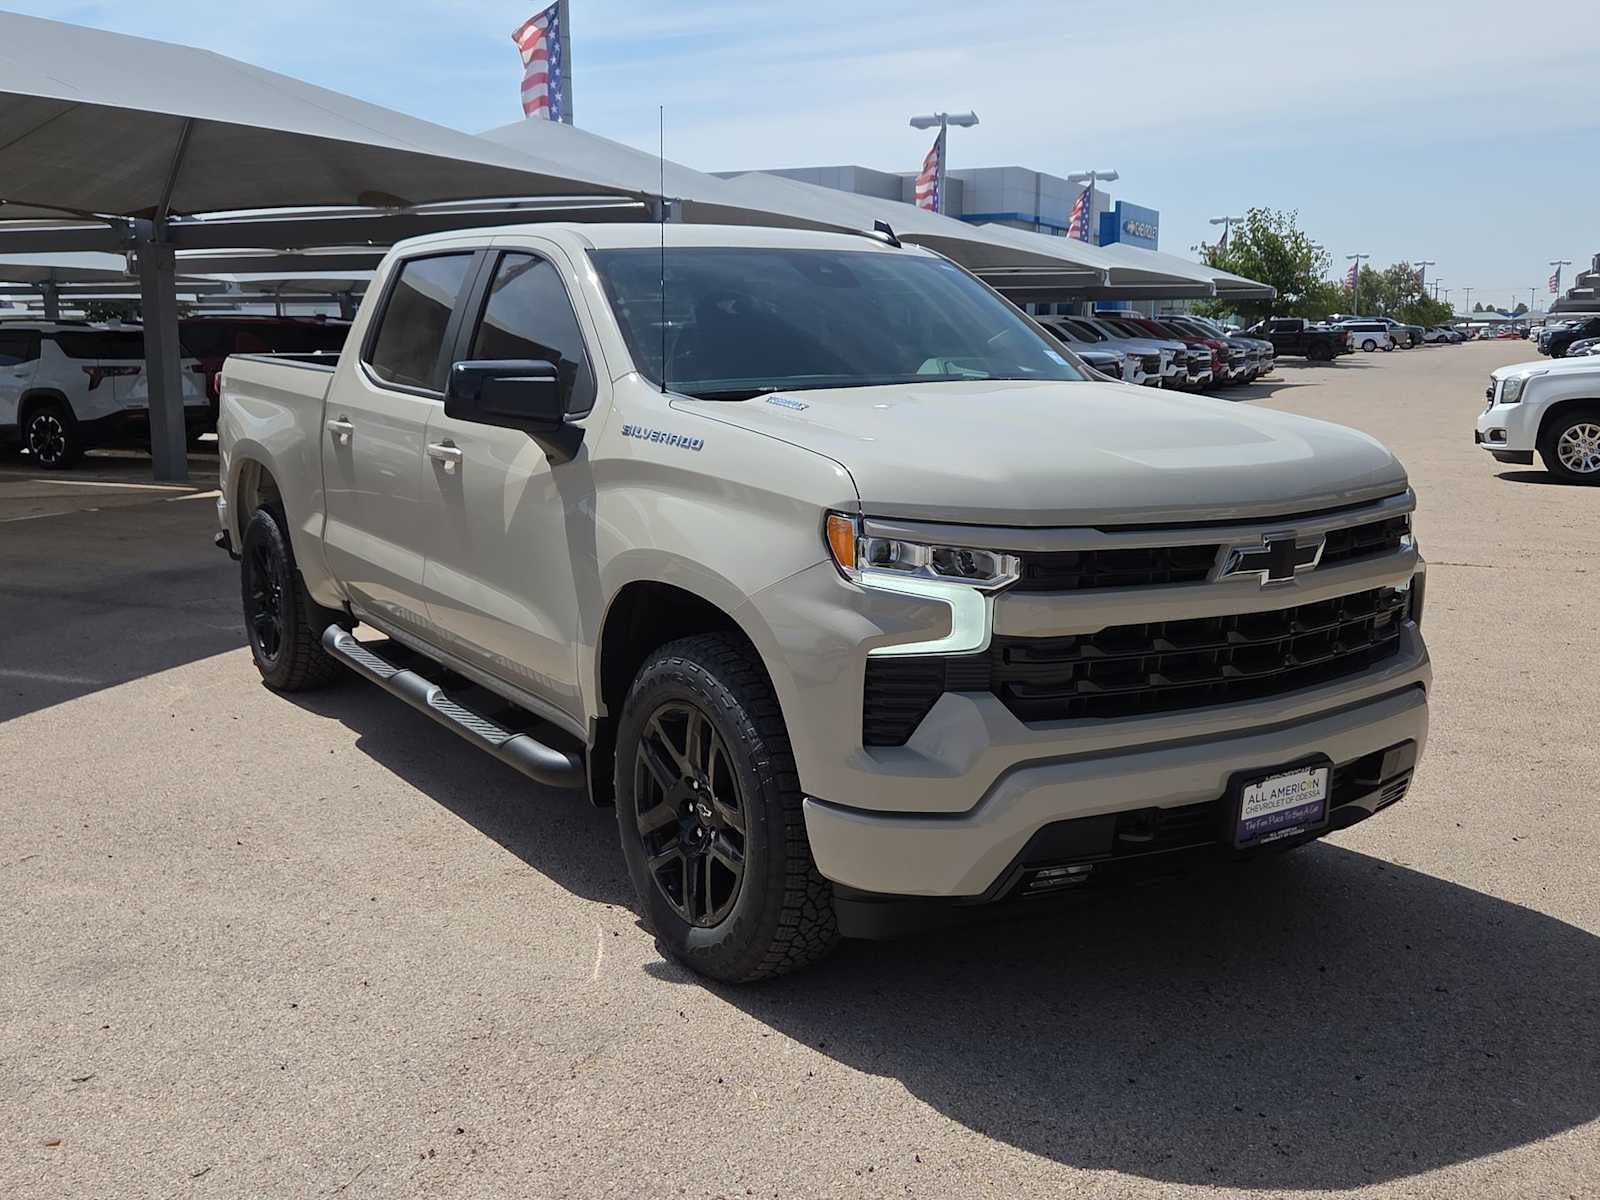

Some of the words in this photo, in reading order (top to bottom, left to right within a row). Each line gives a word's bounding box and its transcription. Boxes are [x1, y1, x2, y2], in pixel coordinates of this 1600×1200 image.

[621, 425, 704, 451] SILVERADO
[1246, 799, 1285, 814] CHEVROLET
[1286, 796, 1294, 804] OF
[1295, 790, 1320, 802] ODESSA
[1248, 792, 1266, 805] ALL
